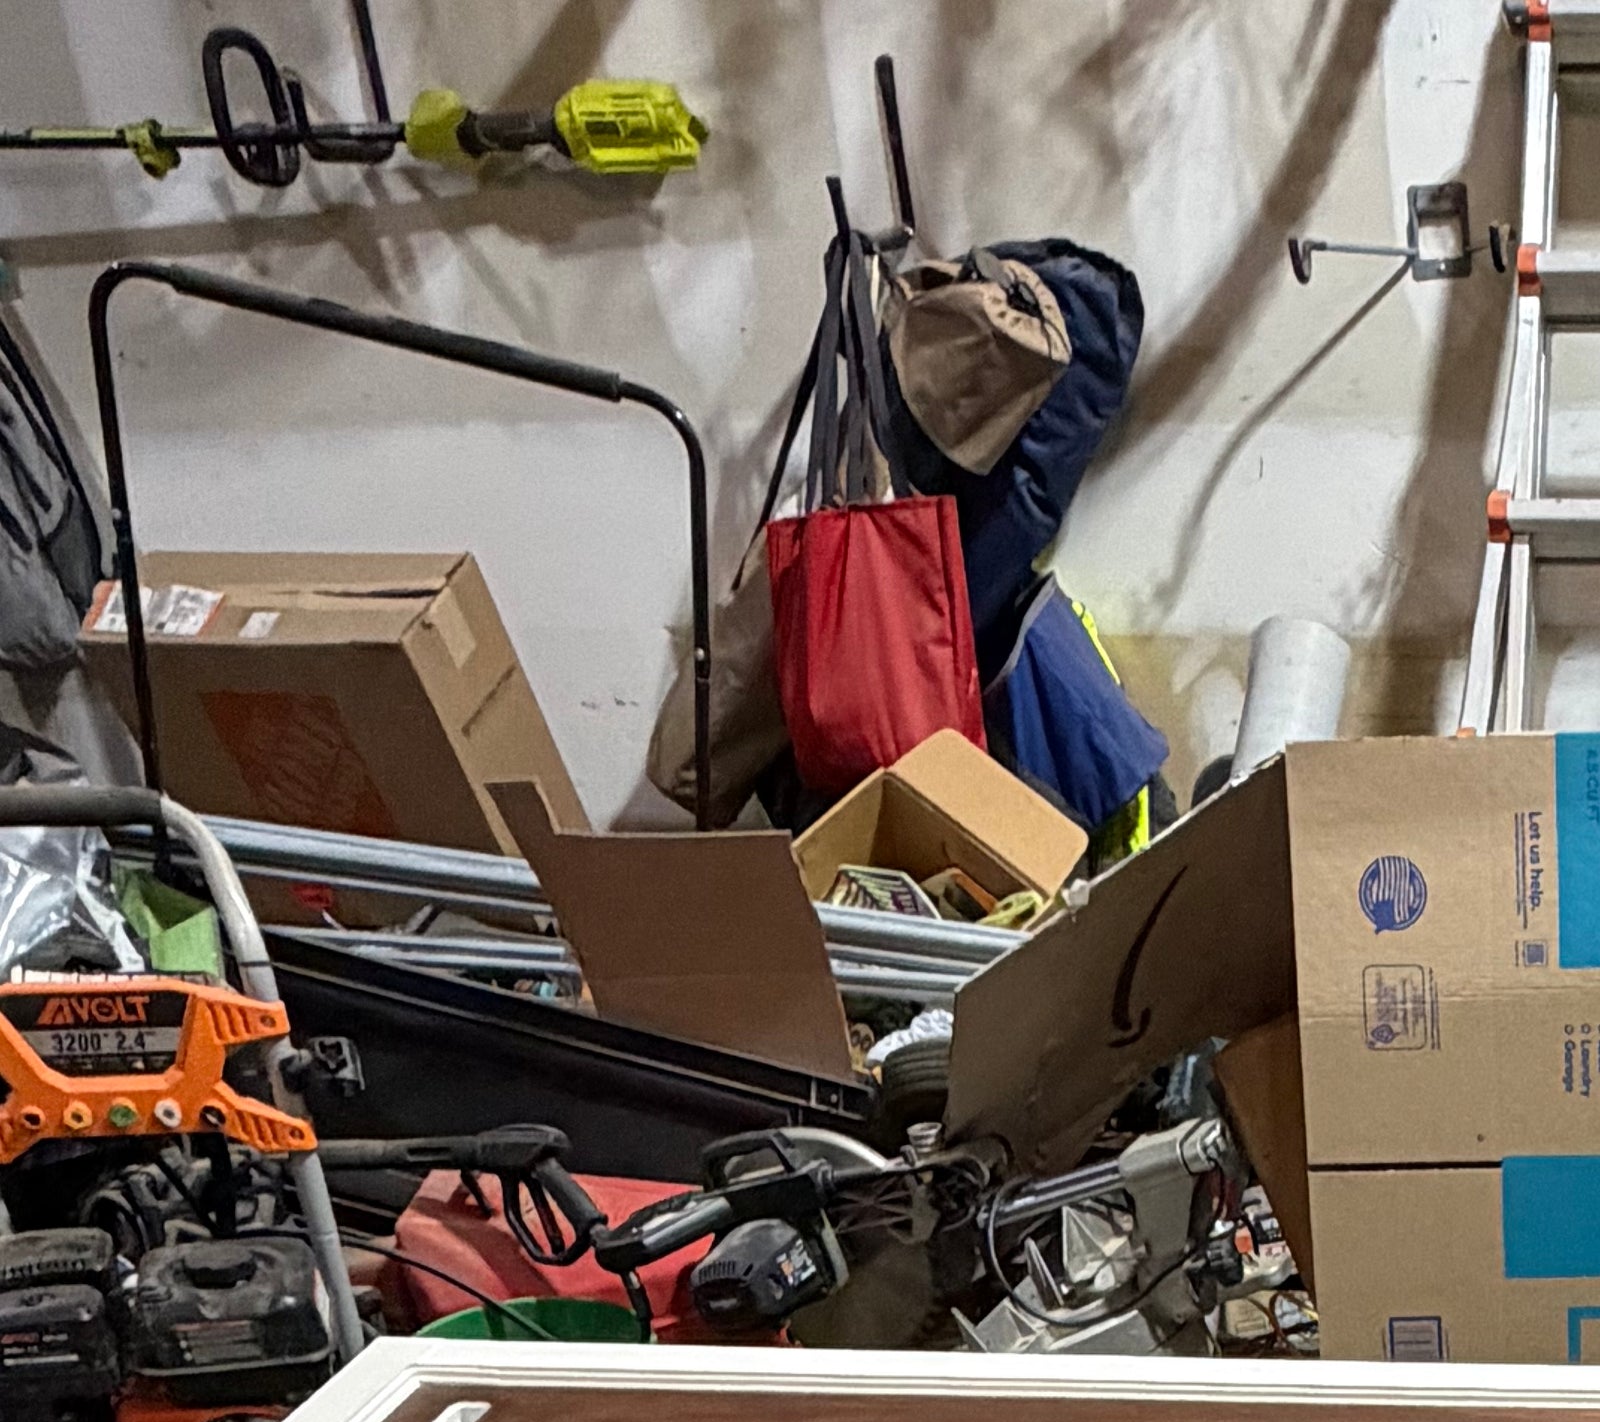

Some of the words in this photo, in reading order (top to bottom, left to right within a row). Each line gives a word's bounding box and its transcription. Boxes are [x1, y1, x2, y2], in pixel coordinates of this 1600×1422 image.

[1528, 812, 1543, 841] Let
[1529, 844, 1541, 864] us
[1529, 868, 1544, 911] help.
[51, 1033, 101, 1052] 3200
[1562, 1040, 1576, 1092] Garage
[1580, 1040, 1592, 1097] Laundry
